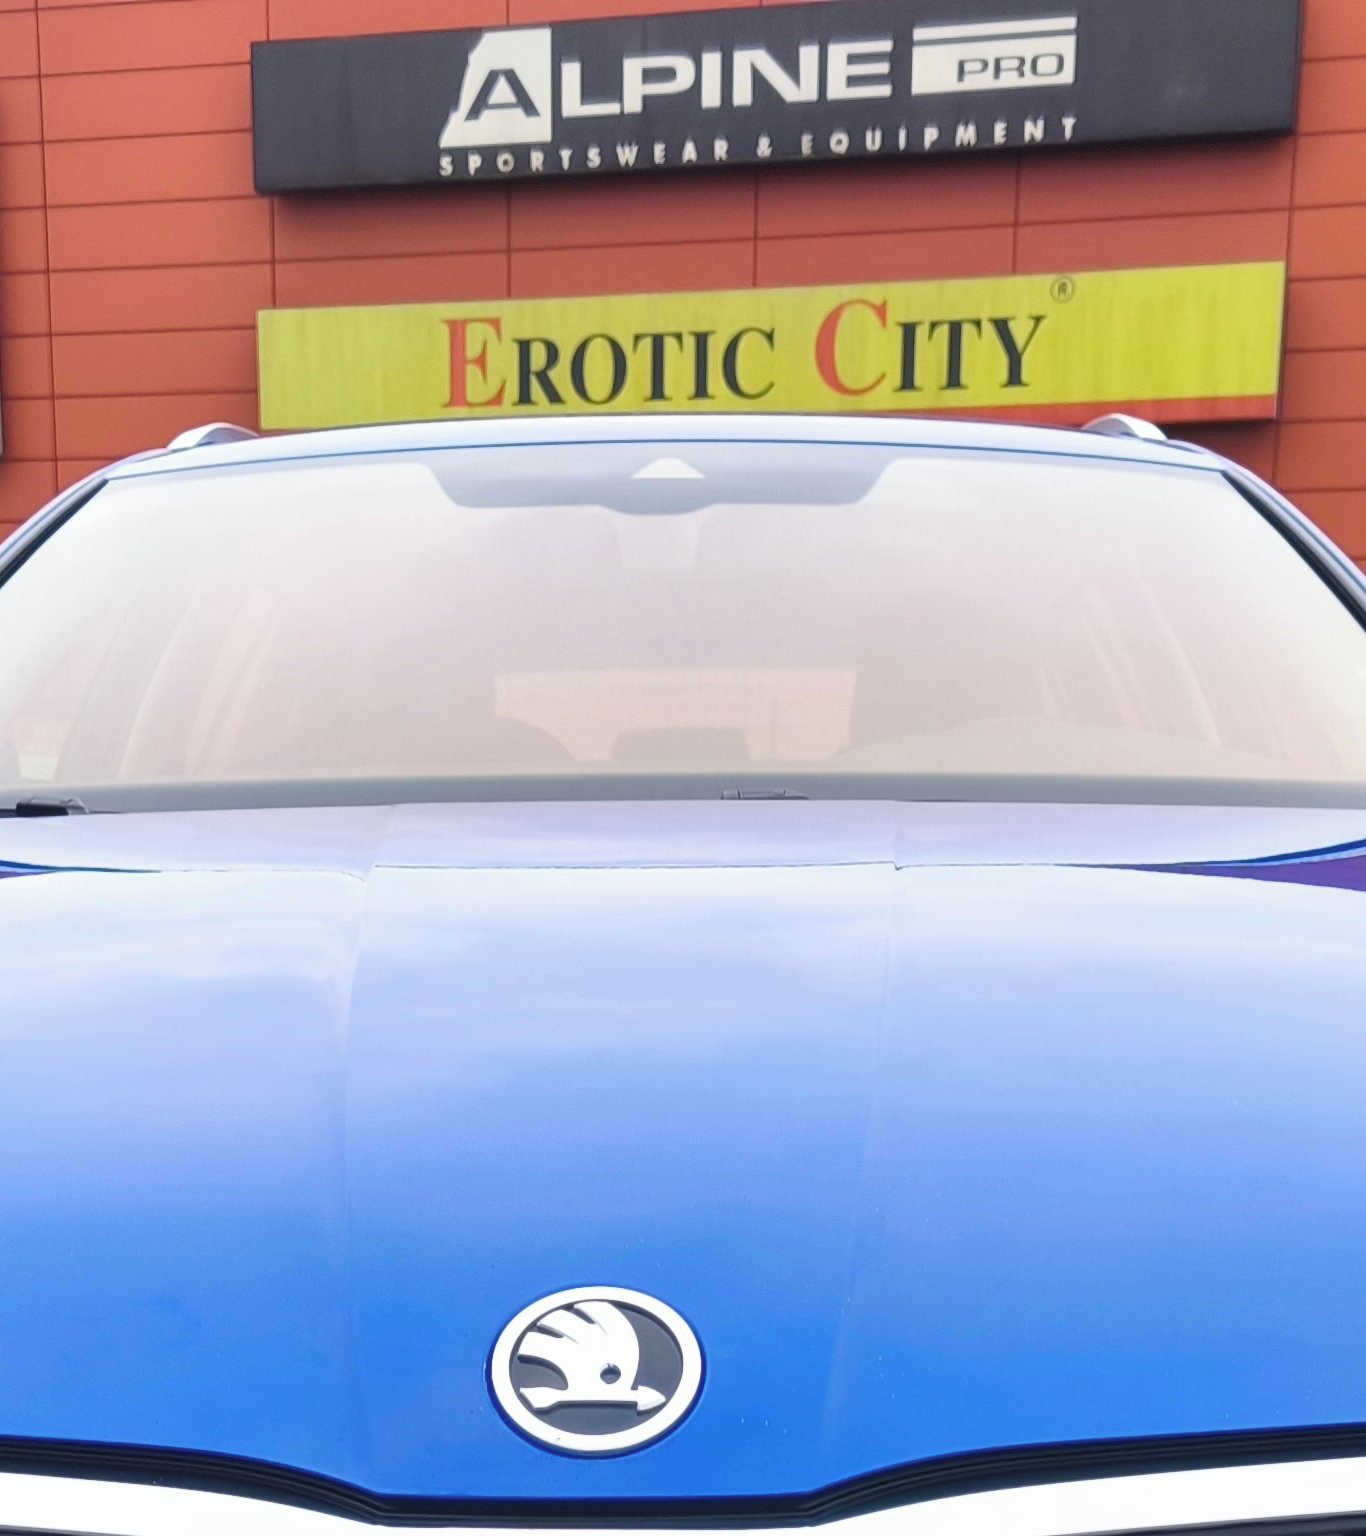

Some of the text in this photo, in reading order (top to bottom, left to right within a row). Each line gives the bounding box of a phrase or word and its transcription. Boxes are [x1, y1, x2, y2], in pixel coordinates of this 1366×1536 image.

[439, 26, 1066, 149] ALPINE PRO
[439, 117, 1078, 177] SPORTSWEAR & EQUIPMENT
